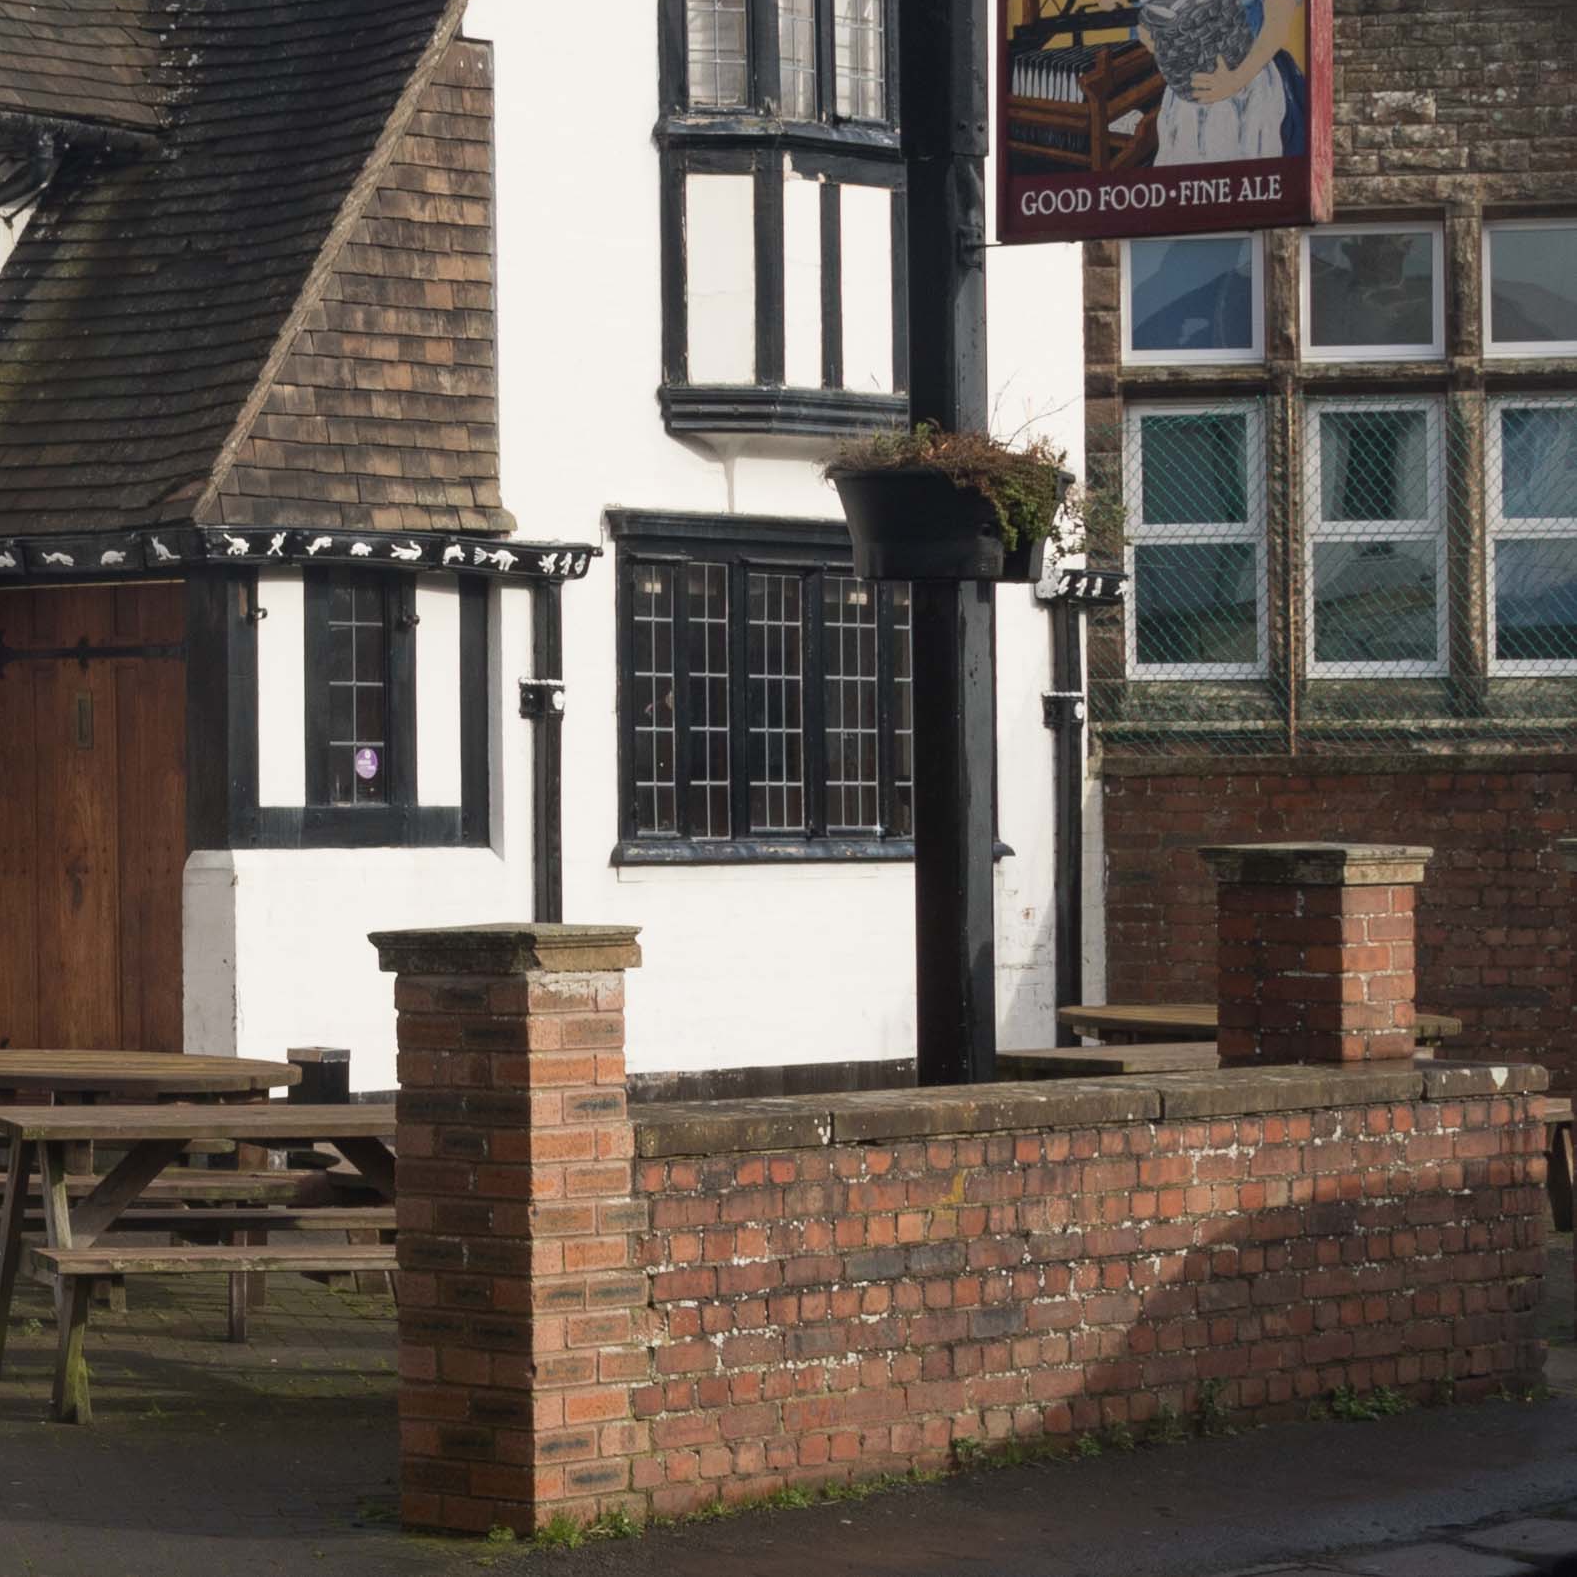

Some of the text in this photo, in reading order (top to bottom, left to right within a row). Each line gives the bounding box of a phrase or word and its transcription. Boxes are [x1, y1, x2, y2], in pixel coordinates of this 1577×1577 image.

[1021, 174, 1282, 215] GOOD FOOD FINE ALE
